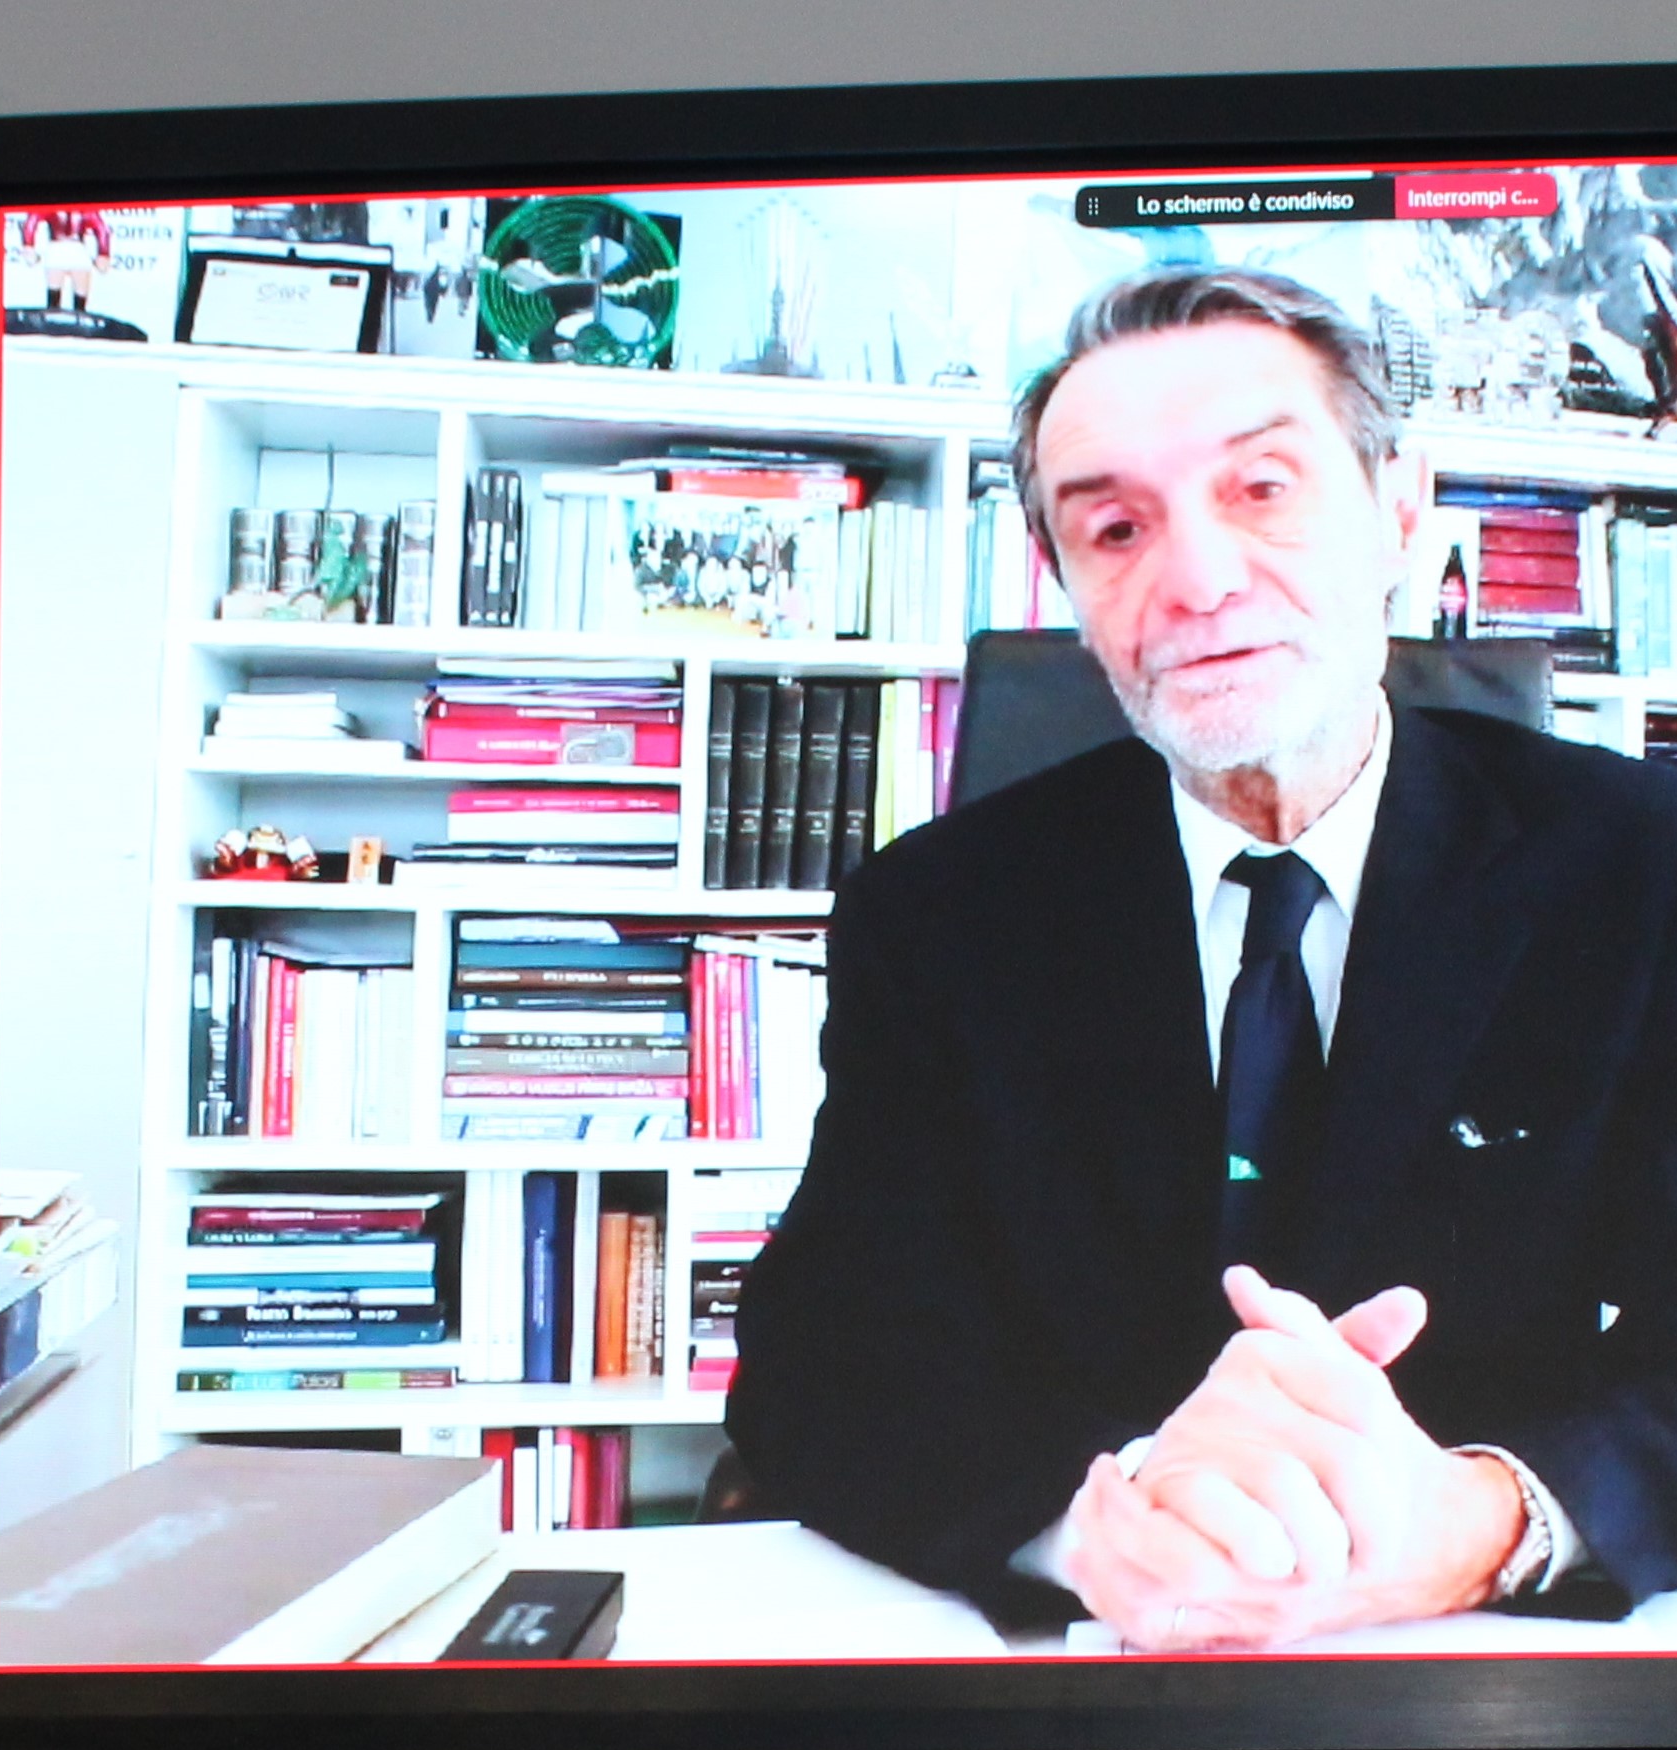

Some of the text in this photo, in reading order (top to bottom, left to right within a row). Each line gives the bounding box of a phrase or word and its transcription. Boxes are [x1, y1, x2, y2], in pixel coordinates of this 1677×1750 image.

[1137, 190, 1355, 215] Lo schermo è condiviso
[1407, 187, 1507, 211] Interrompi
